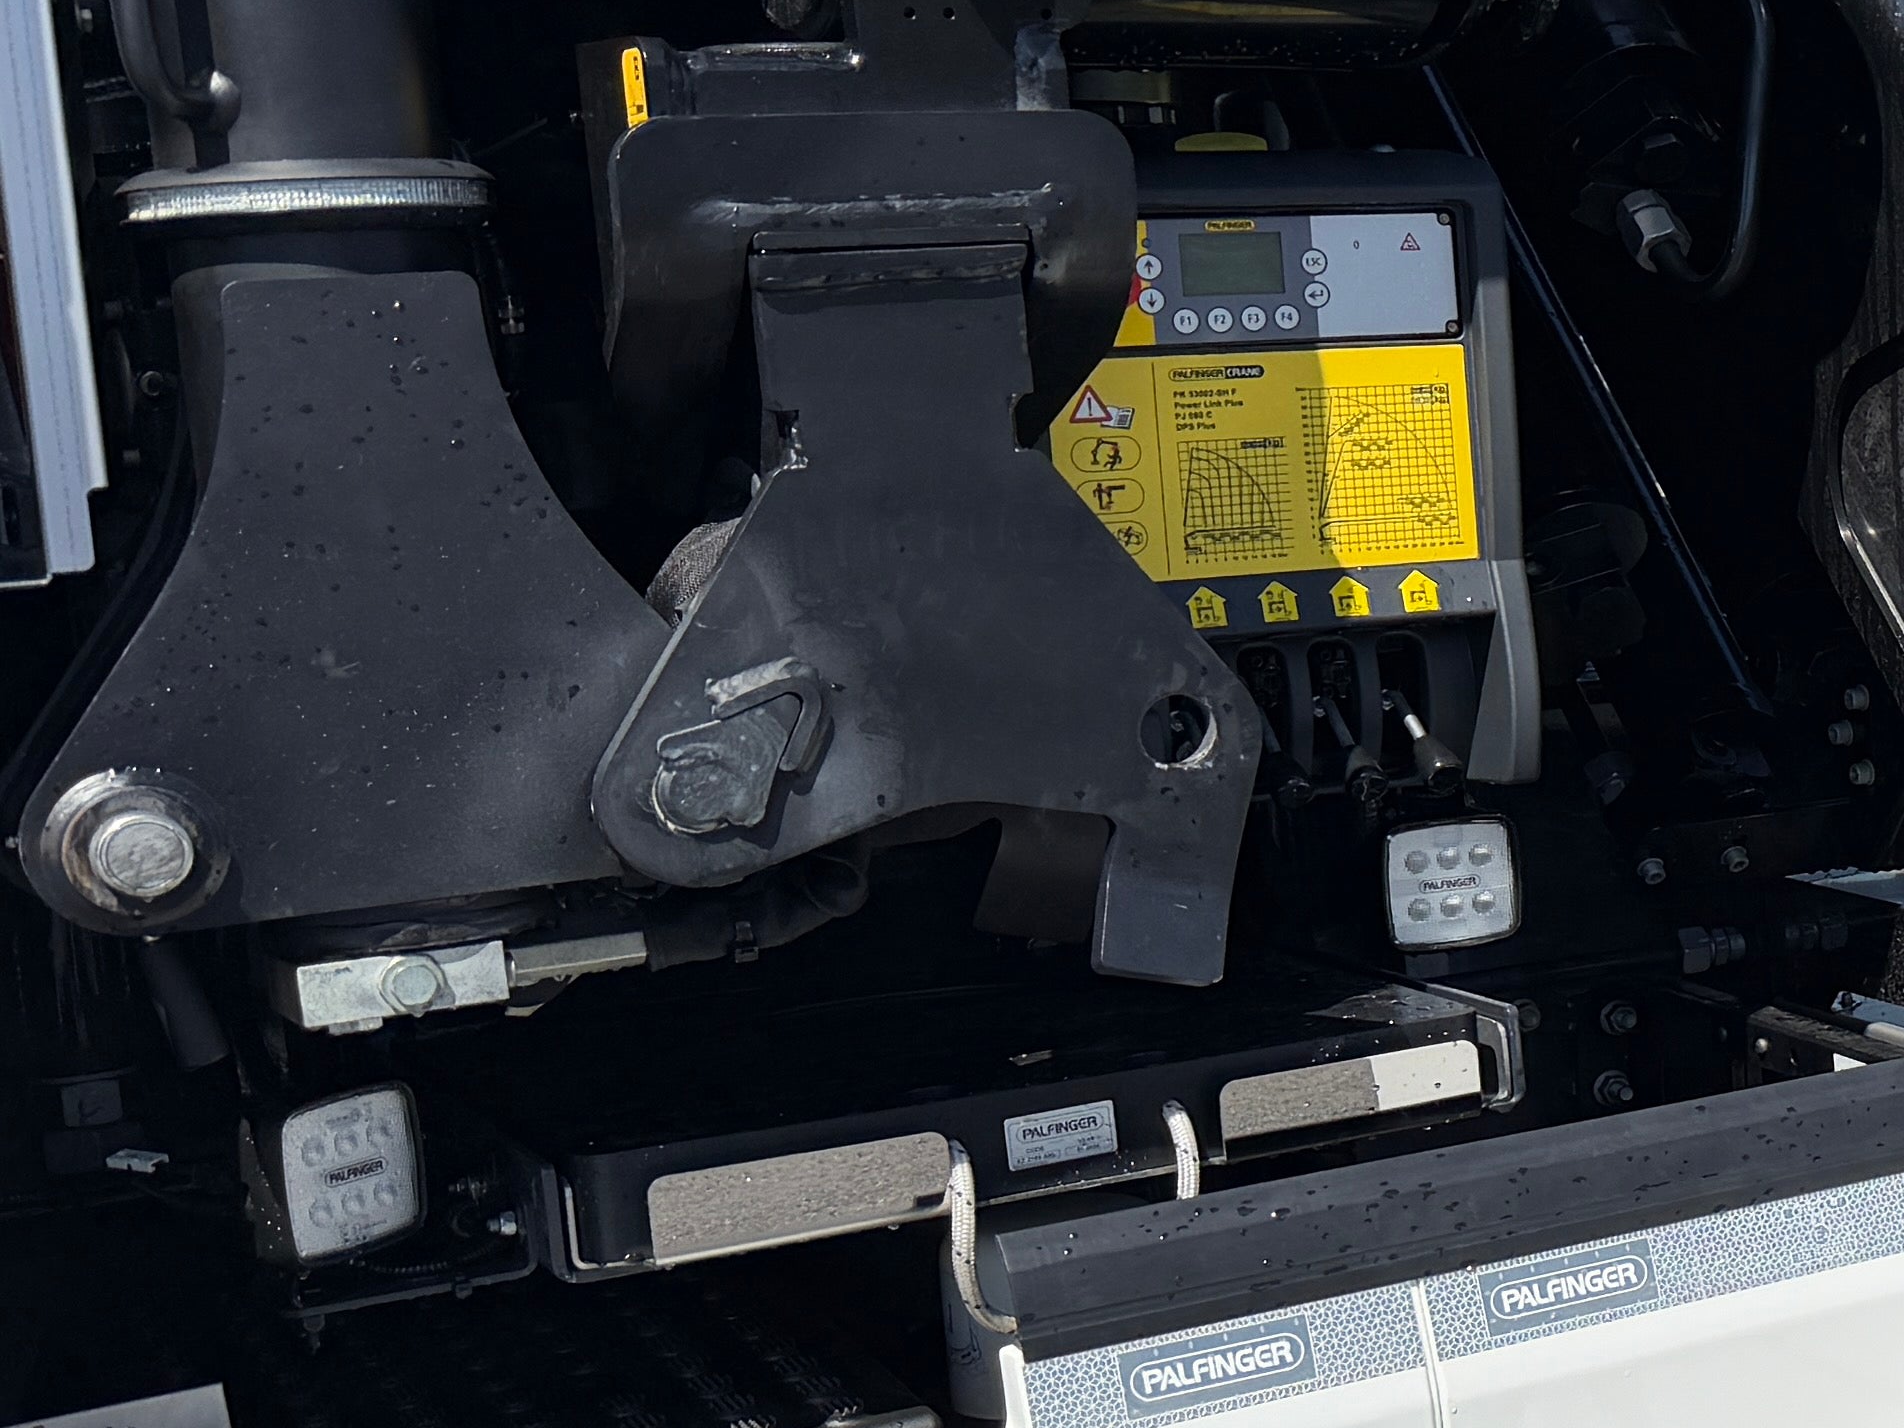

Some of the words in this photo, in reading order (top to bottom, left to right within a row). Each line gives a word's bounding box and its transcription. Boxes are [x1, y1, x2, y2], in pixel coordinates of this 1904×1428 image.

[1214, 315, 1226, 325] F2
[1281, 312, 1293, 322] F4
[1423, 876, 1477, 892] PALFINGER
[1022, 1115, 1098, 1141] PALFINGER
[329, 1159, 384, 1185] PALFINGER
[1501, 1262, 1639, 1315] PALFINGER
[1142, 1339, 1294, 1395] PALFINGER
